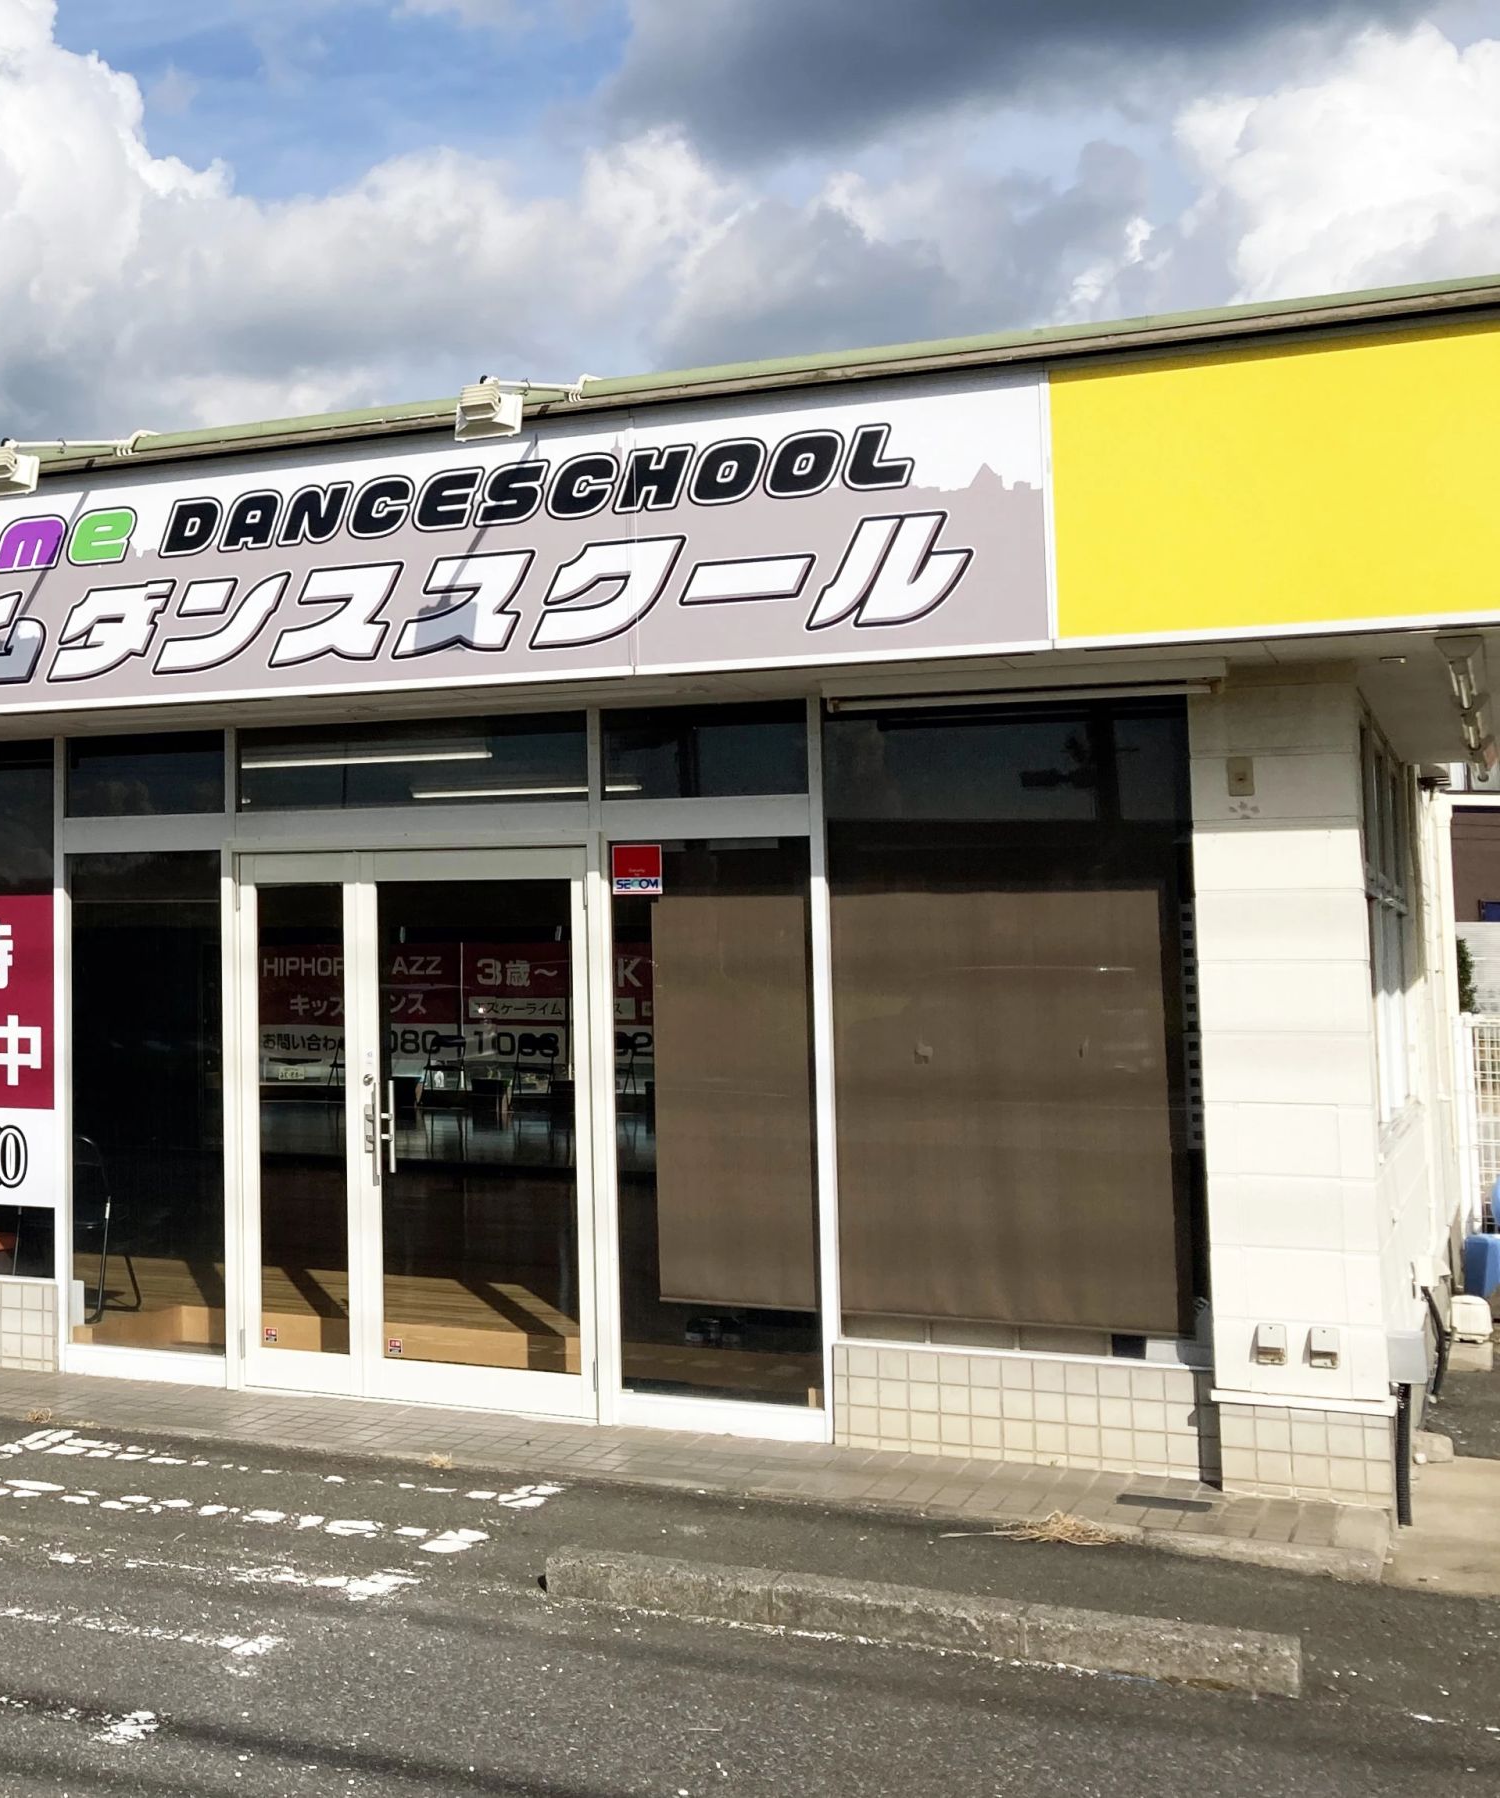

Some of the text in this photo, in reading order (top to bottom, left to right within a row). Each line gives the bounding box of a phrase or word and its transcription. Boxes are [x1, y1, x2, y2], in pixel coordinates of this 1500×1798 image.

[159, 423, 915, 558] DANCESCHOOL
[615, 878, 660, 890] SECOM
[392, 956, 442, 975] AZZ
[389, 993, 427, 1015] ンス
[262, 1033, 344, 1052] お問い合わ
